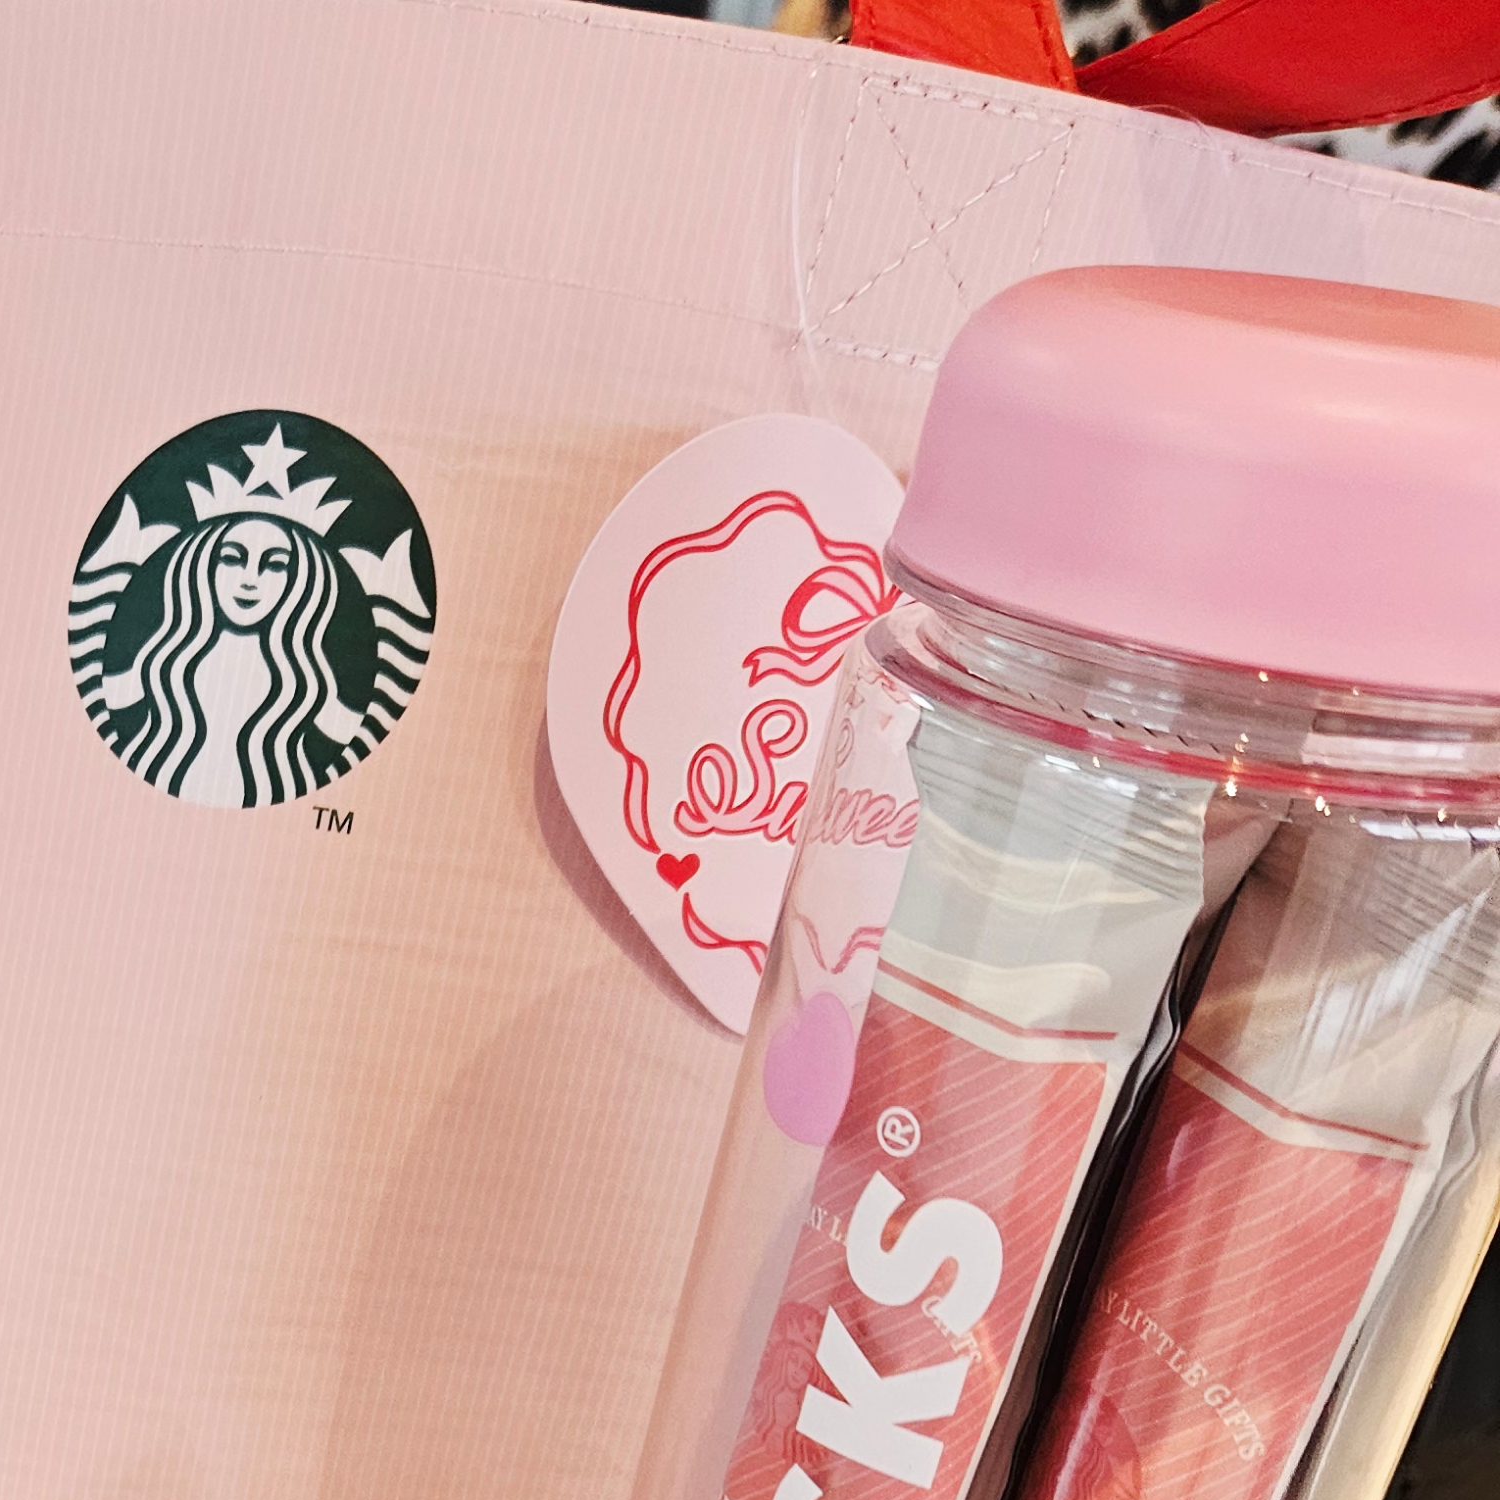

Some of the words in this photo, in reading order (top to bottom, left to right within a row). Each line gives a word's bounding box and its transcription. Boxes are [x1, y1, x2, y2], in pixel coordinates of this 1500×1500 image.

[313, 806, 354, 835] TM
[1118, 1300, 1208, 1388] LITTLE
[1204, 1383, 1267, 1461] GIFTS
